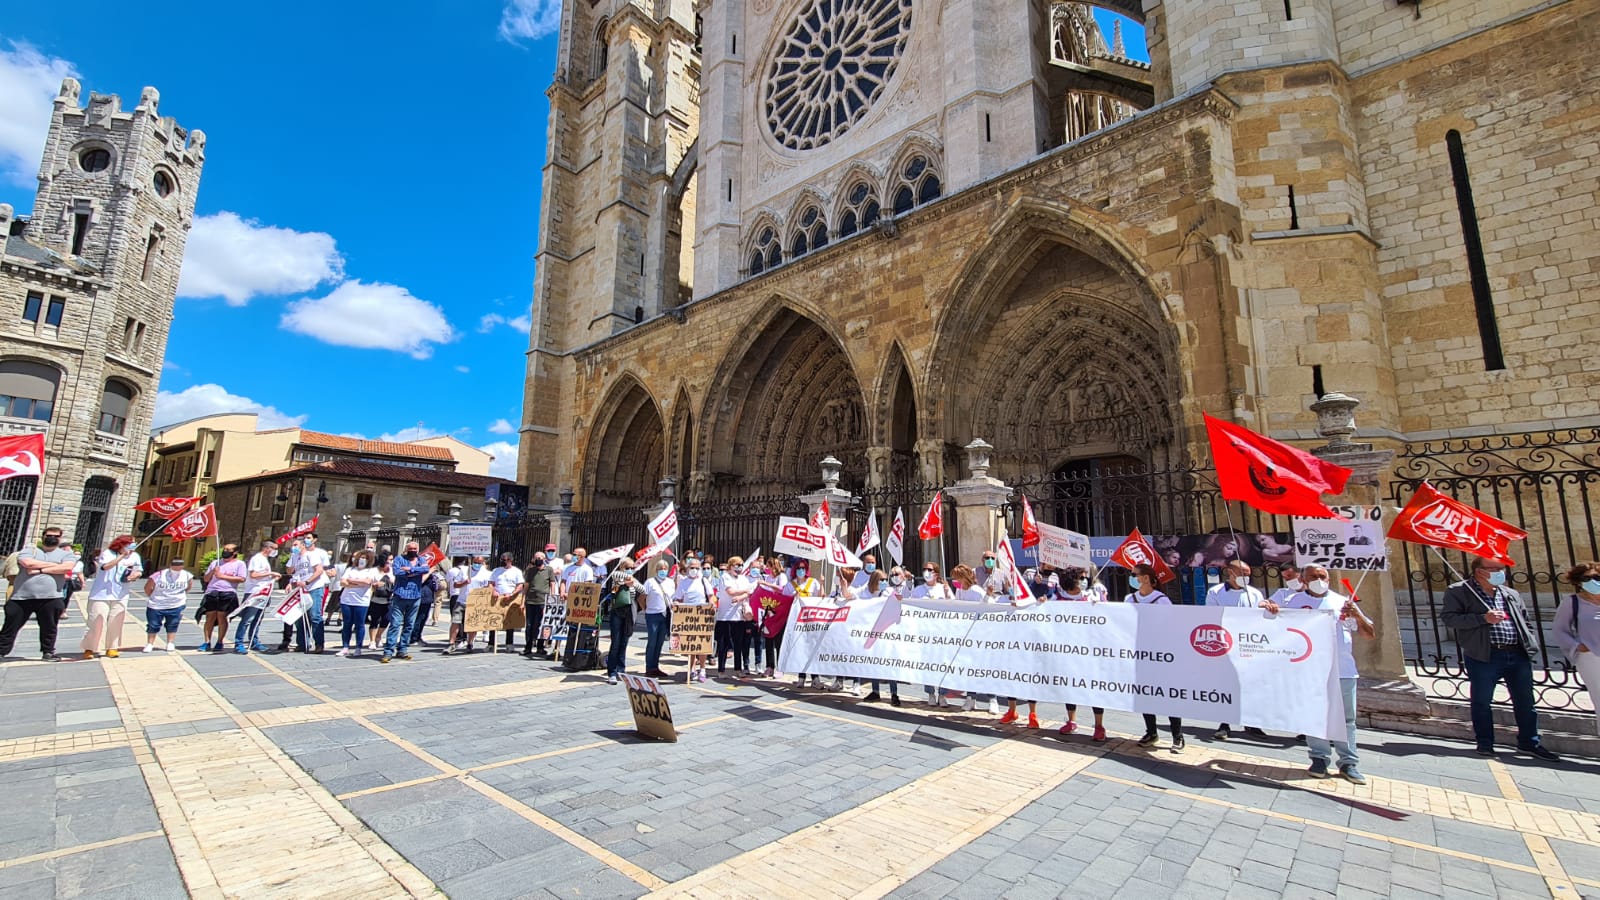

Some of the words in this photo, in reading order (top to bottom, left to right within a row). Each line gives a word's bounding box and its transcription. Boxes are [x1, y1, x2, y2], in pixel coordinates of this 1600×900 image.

[1424, 503, 1475, 536] UGT
[1296, 542, 1346, 557] VETE
[545, 604, 565, 615] POR
[574, 597, 579, 607] O
[582, 596, 592, 608] TÚ
[900, 609, 911, 617] LA
[912, 610, 960, 620] PLANTILLA
[962, 613, 975, 621] DE
[977, 612, 1052, 623] LABORATOROS
[1054, 613, 1107, 625] OVEJERO
[794, 622, 830, 632] industria
[1195, 628, 1228, 644] UGT
[1238, 632, 1270, 644] FICA
[850, 629, 862, 638] EN
[863, 630, 902, 642] DEFENSA
[904, 633, 916, 642] DE
[918, 635, 931, 644] SU
[932, 636, 973, 648] SALARIO
[976, 640, 982, 648] Y
[985, 641, 1005, 649] POR
[1008, 641, 1021, 650] LA
[1023, 641, 1089, 655] VIABILIDAD
[1092, 647, 1116, 658] DEL
[1119, 648, 1175, 663] EMPLEO
[818, 653, 829, 662] NO
[830, 652, 848, 662] MÁS
[849, 655, 955, 674] DESINDUSTRIALIZACIÓN
[958, 666, 965, 676] Y
[967, 668, 1050, 685] DESPOBLACIÓN
[1052, 675, 1069, 686] EN
[1072, 677, 1087, 689] LA
[1090, 679, 1165, 698] PROVINCIA
[1169, 687, 1188, 700] DE
[1192, 688, 1233, 705] LEÓN
[630, 688, 672, 723] RATA
